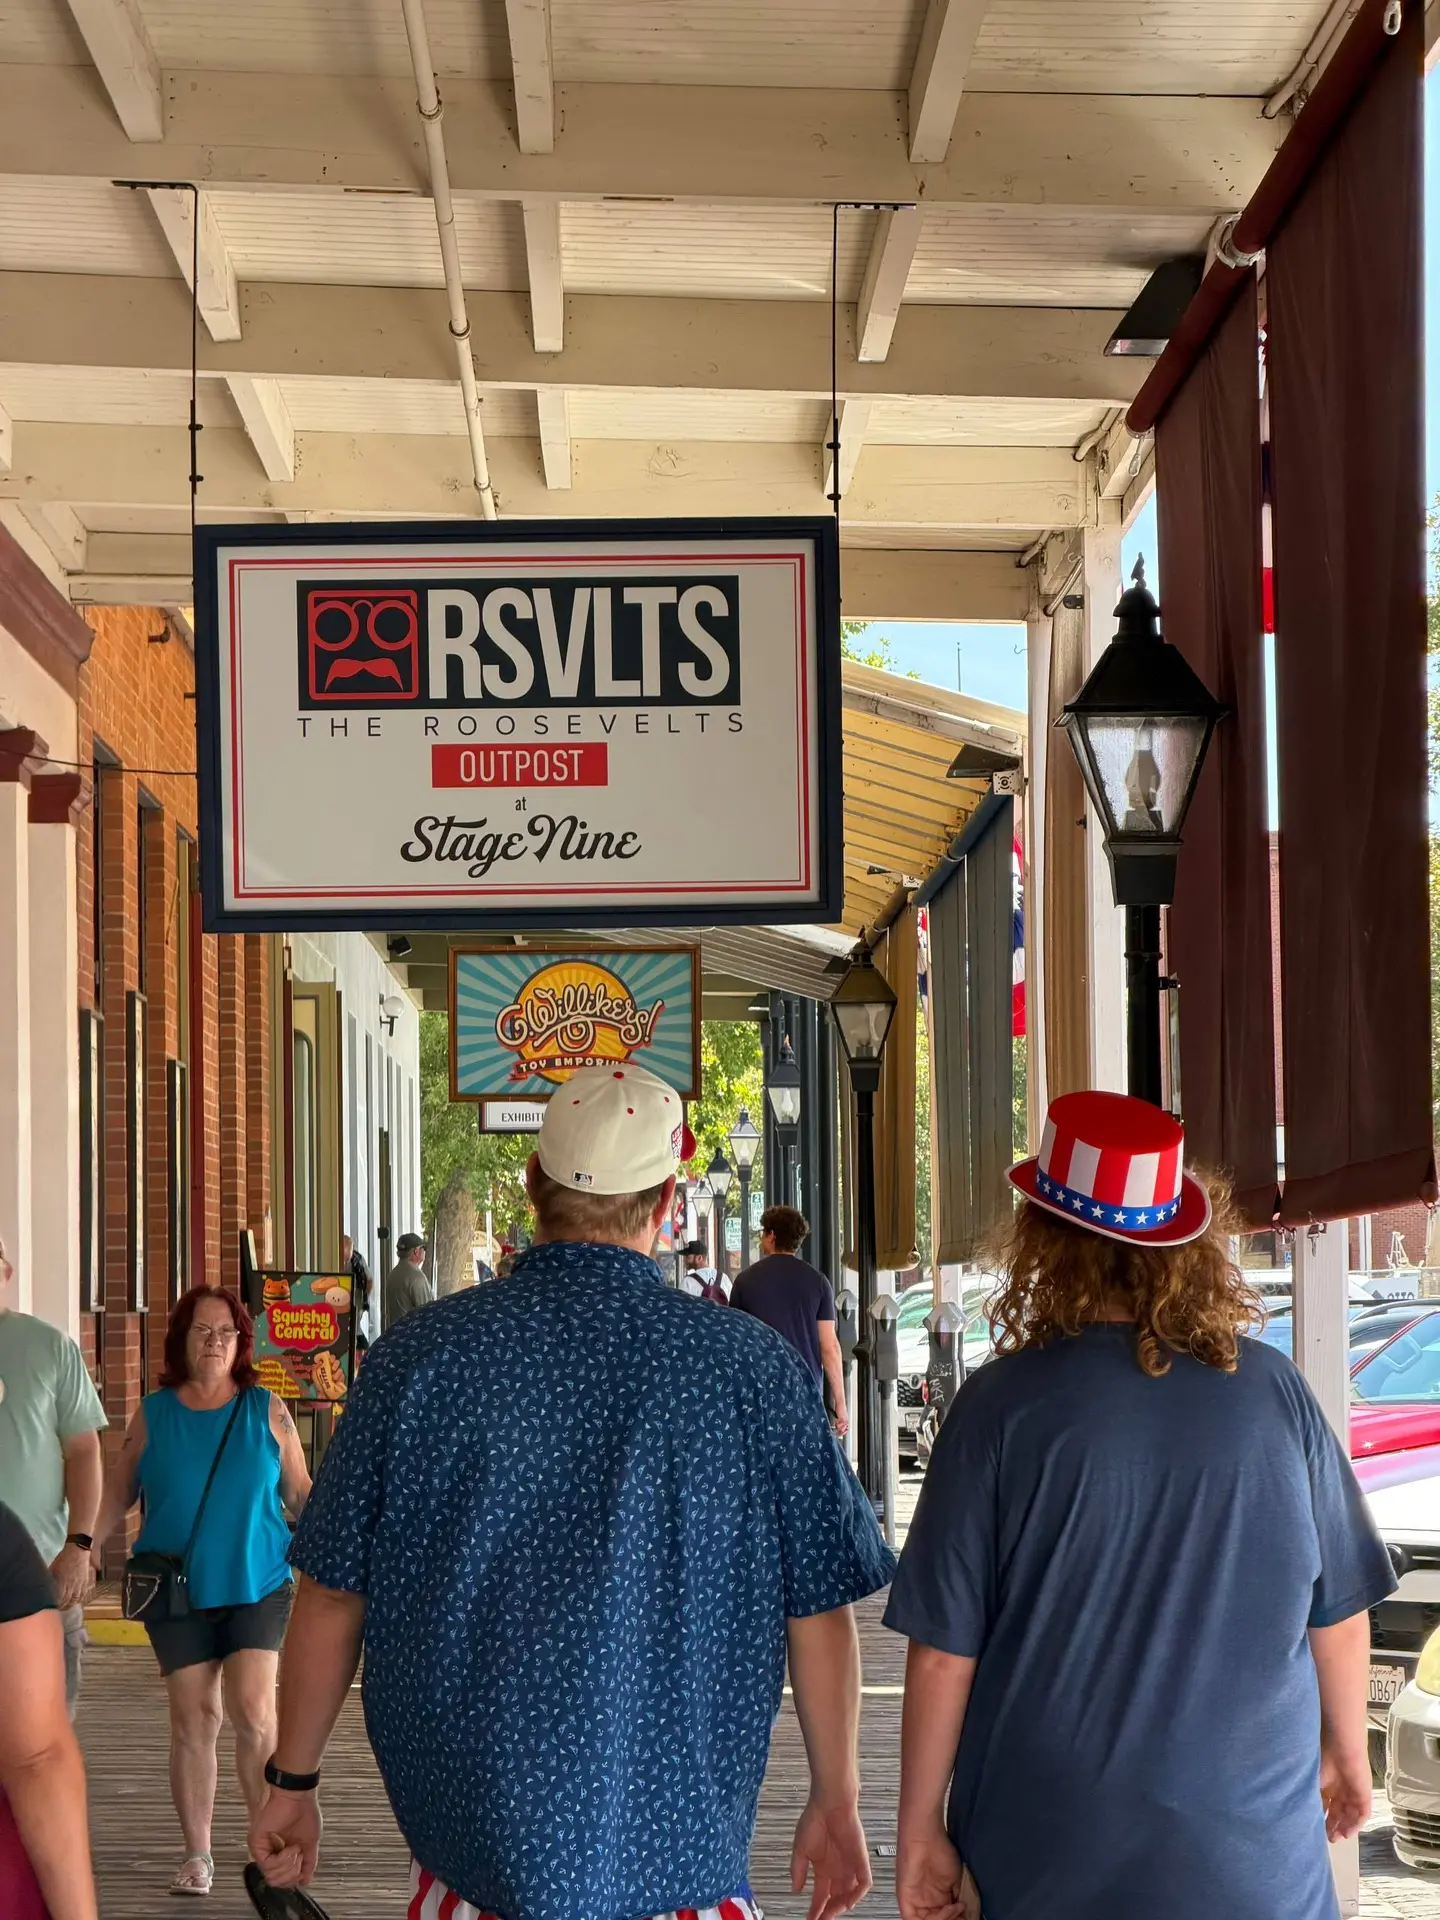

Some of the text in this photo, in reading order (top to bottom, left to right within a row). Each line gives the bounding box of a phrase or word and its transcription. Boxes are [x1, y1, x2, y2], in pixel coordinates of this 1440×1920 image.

[428, 584, 731, 700] RSVLTS
[297, 712, 744, 738] THE ROOSEVELTS
[459, 749, 584, 783] OUTPOST
[515, 796, 527, 811] at
[520, 1056, 624, 1073] TOY EMPORIU
[272, 1308, 331, 1328] Squishy
[274, 1322, 335, 1340] Central
